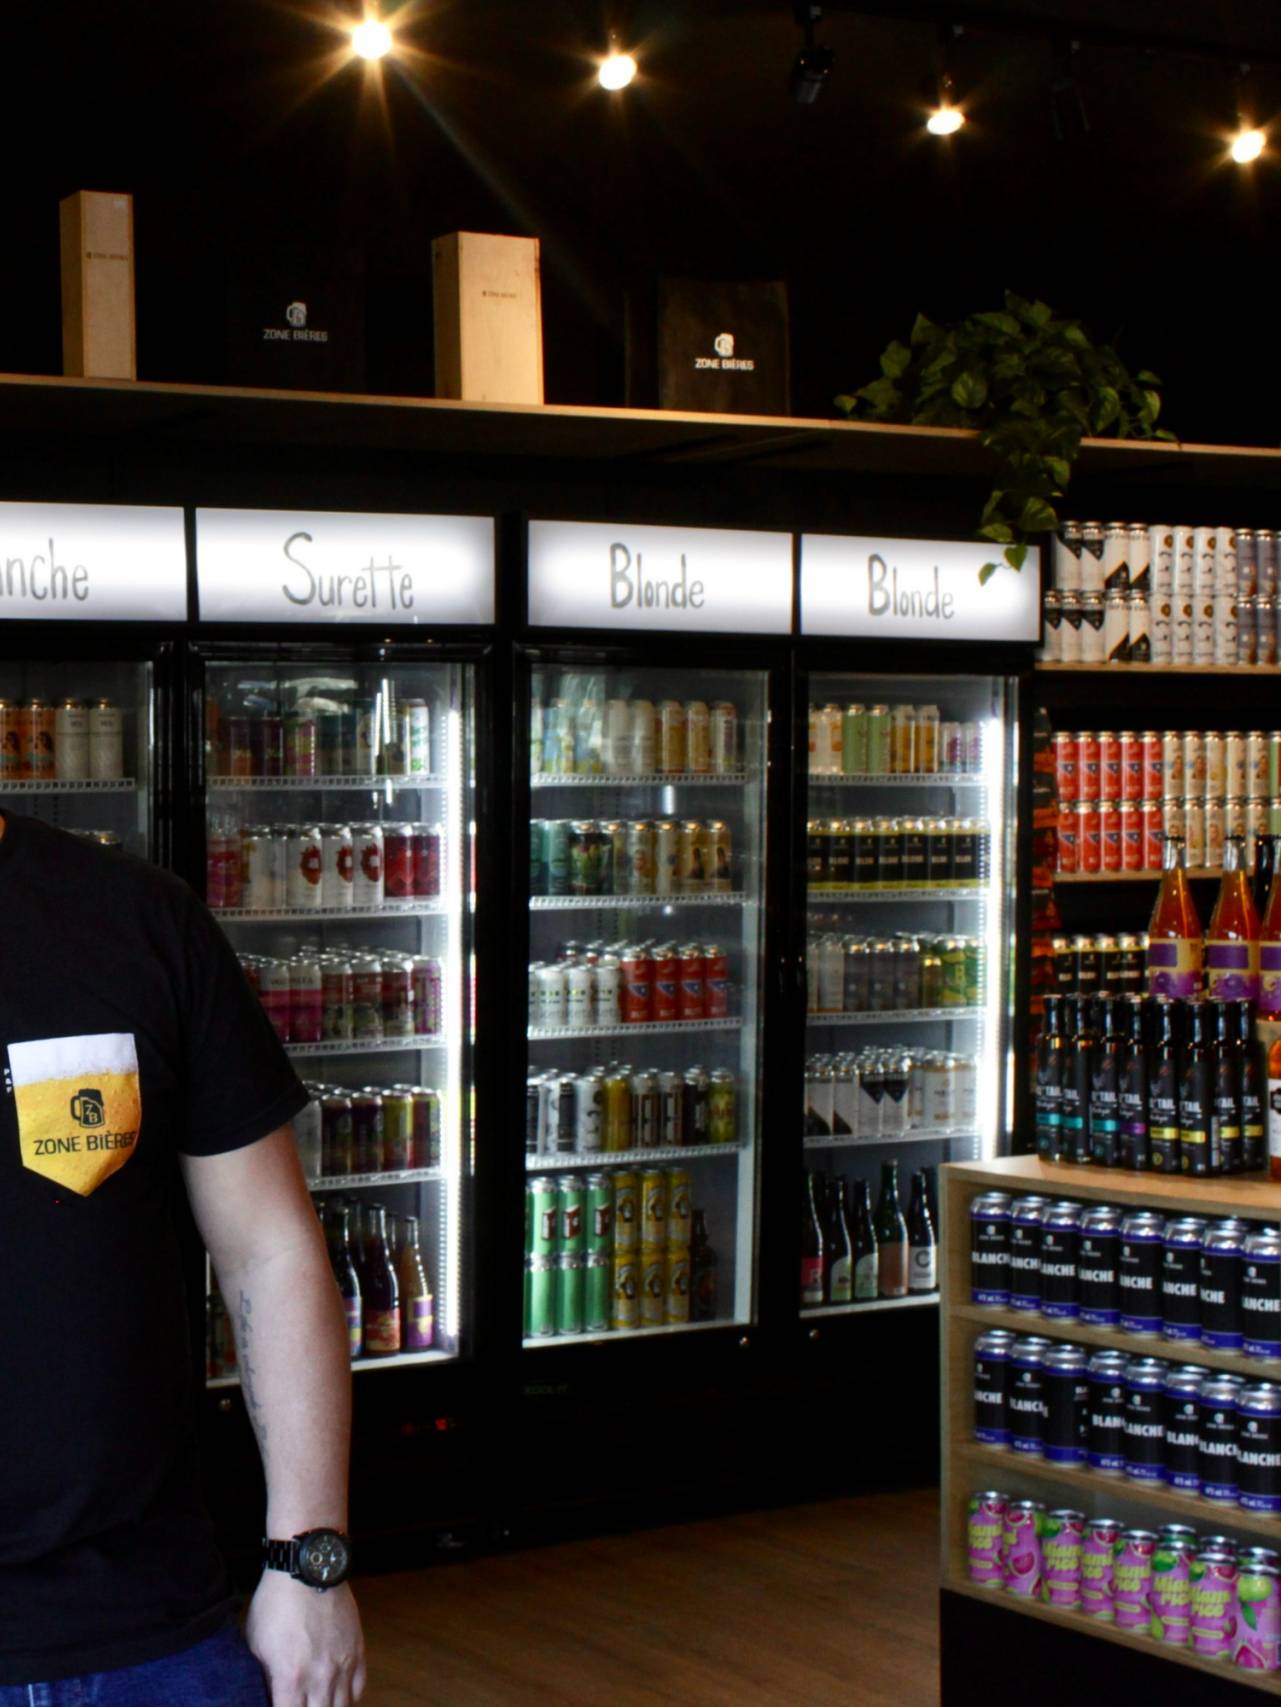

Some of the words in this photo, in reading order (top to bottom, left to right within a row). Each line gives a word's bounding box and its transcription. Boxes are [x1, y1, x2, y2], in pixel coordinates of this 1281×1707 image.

[263, 328, 290, 341] ZONE
[694, 358, 721, 370] ZONE
[282, 531, 415, 611] Surette
[609, 542, 705, 610] Blonde
[867, 553, 956, 620] Blonde
[33, 1135, 81, 1156] ZONE
